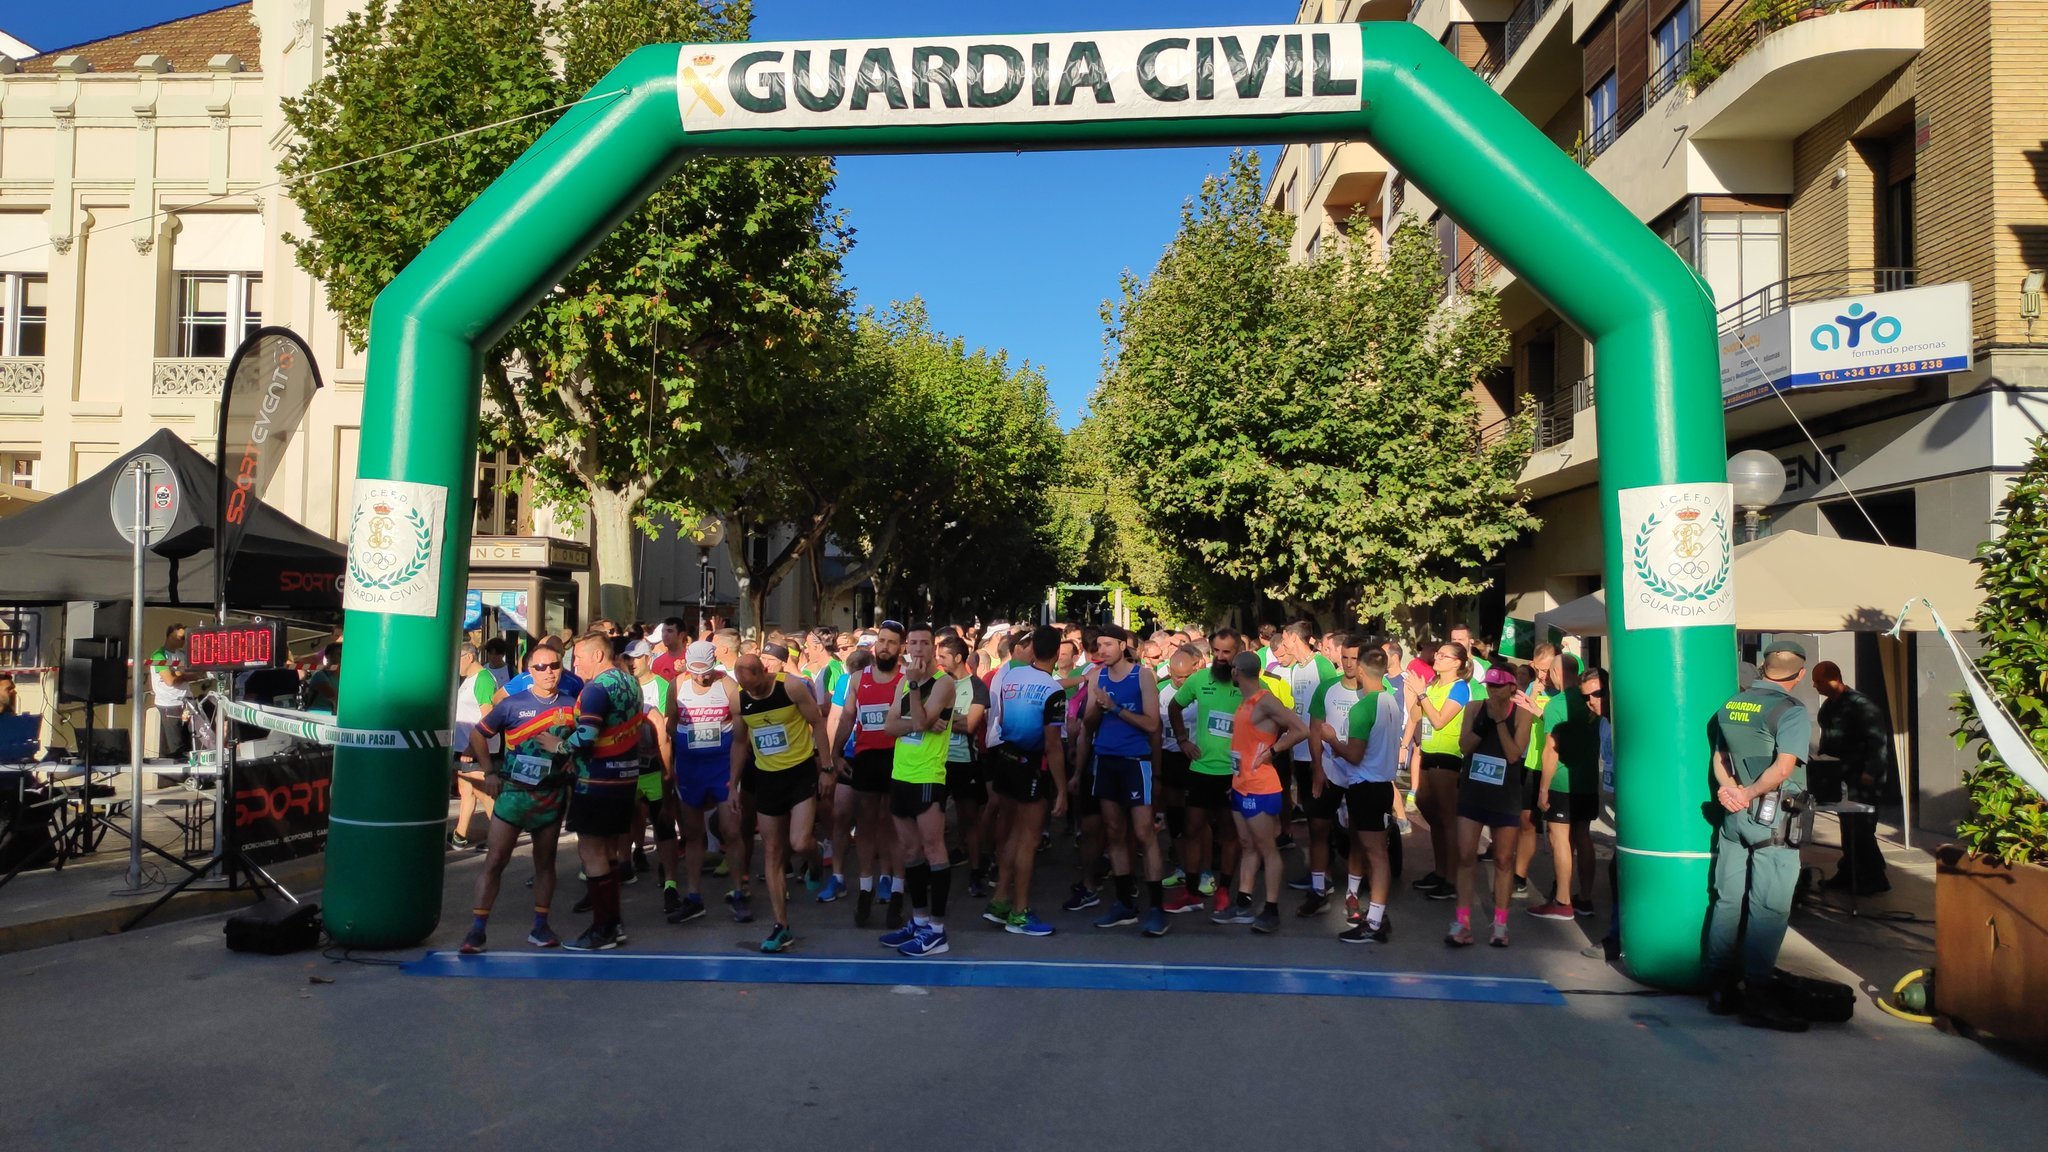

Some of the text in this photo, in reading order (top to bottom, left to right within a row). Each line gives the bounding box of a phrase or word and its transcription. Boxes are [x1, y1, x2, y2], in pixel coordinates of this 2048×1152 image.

[727, 32, 1357, 114] GUARDIA CIVIL
[1852, 341, 1946, 358] formando personas
[1818, 359, 1944, 381] Tel. +34 974 238 238
[562, 550, 586, 564] ONCE
[348, 576, 425, 603] UARDIA CIVIL
[1639, 589, 1731, 617] GUARDIA CIVIL
[191, 630, 270, 664] 00:00:00
[1725, 701, 1762, 713] GUARDIA
[865, 711, 884, 724] 198
[1729, 711, 1750, 722] CIVIL
[1215, 718, 1231, 732] 141
[341, 731, 354, 744] CIVIL
[355, 733, 366, 745] NO
[368, 733, 396, 746] PASAR
[694, 729, 714, 741] 243
[758, 733, 781, 748] 205
[521, 762, 541, 778] 214
[1477, 761, 1497, 776] 247
